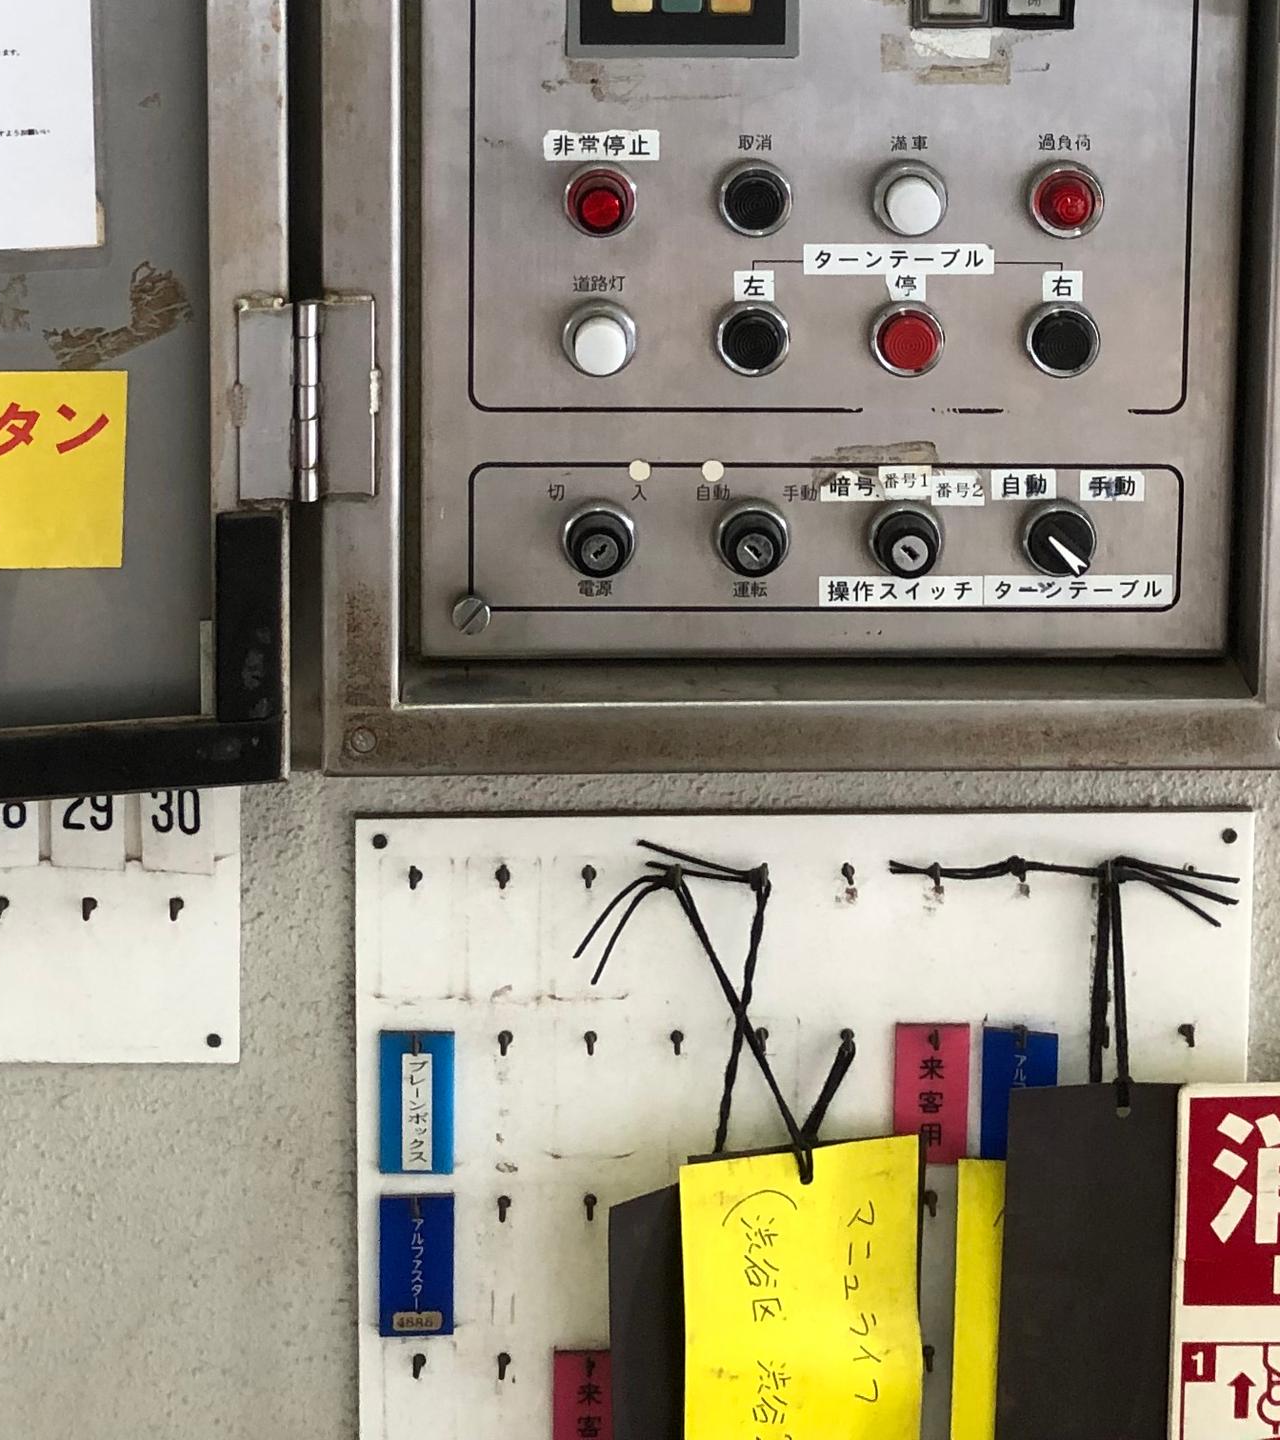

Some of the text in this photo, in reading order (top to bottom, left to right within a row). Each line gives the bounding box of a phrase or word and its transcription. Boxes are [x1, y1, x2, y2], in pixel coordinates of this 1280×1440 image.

[552, 134, 651, 157] 非常停止
[737, 134, 773, 152] 取消
[1037, 133, 1092, 152] 過負荷
[814, 249, 985, 269] ターンテーブル
[572, 275, 627, 293] 道路灯
[743, 276, 765, 297] 左
[1051, 275, 1073, 298] 右
[829, 475, 876, 497] 暗号
[883, 471, 929, 489] 番号1
[1000, 473, 1048, 497] 自動
[547, 484, 565, 502] 切
[631, 485, 648, 502] 入
[696, 484, 731, 501] 自動
[782, 484, 819, 502] 手動
[935, 481, 984, 499] 番号2
[577, 579, 613, 598] 電源
[732, 580, 768, 599] 運転
[827, 580, 974, 603] 操作スイッチ
[994, 579, 1163, 600] ターンテーブル
[150, 785, 201, 836] 30
[1190, 1353, 1206, 1378] 1
